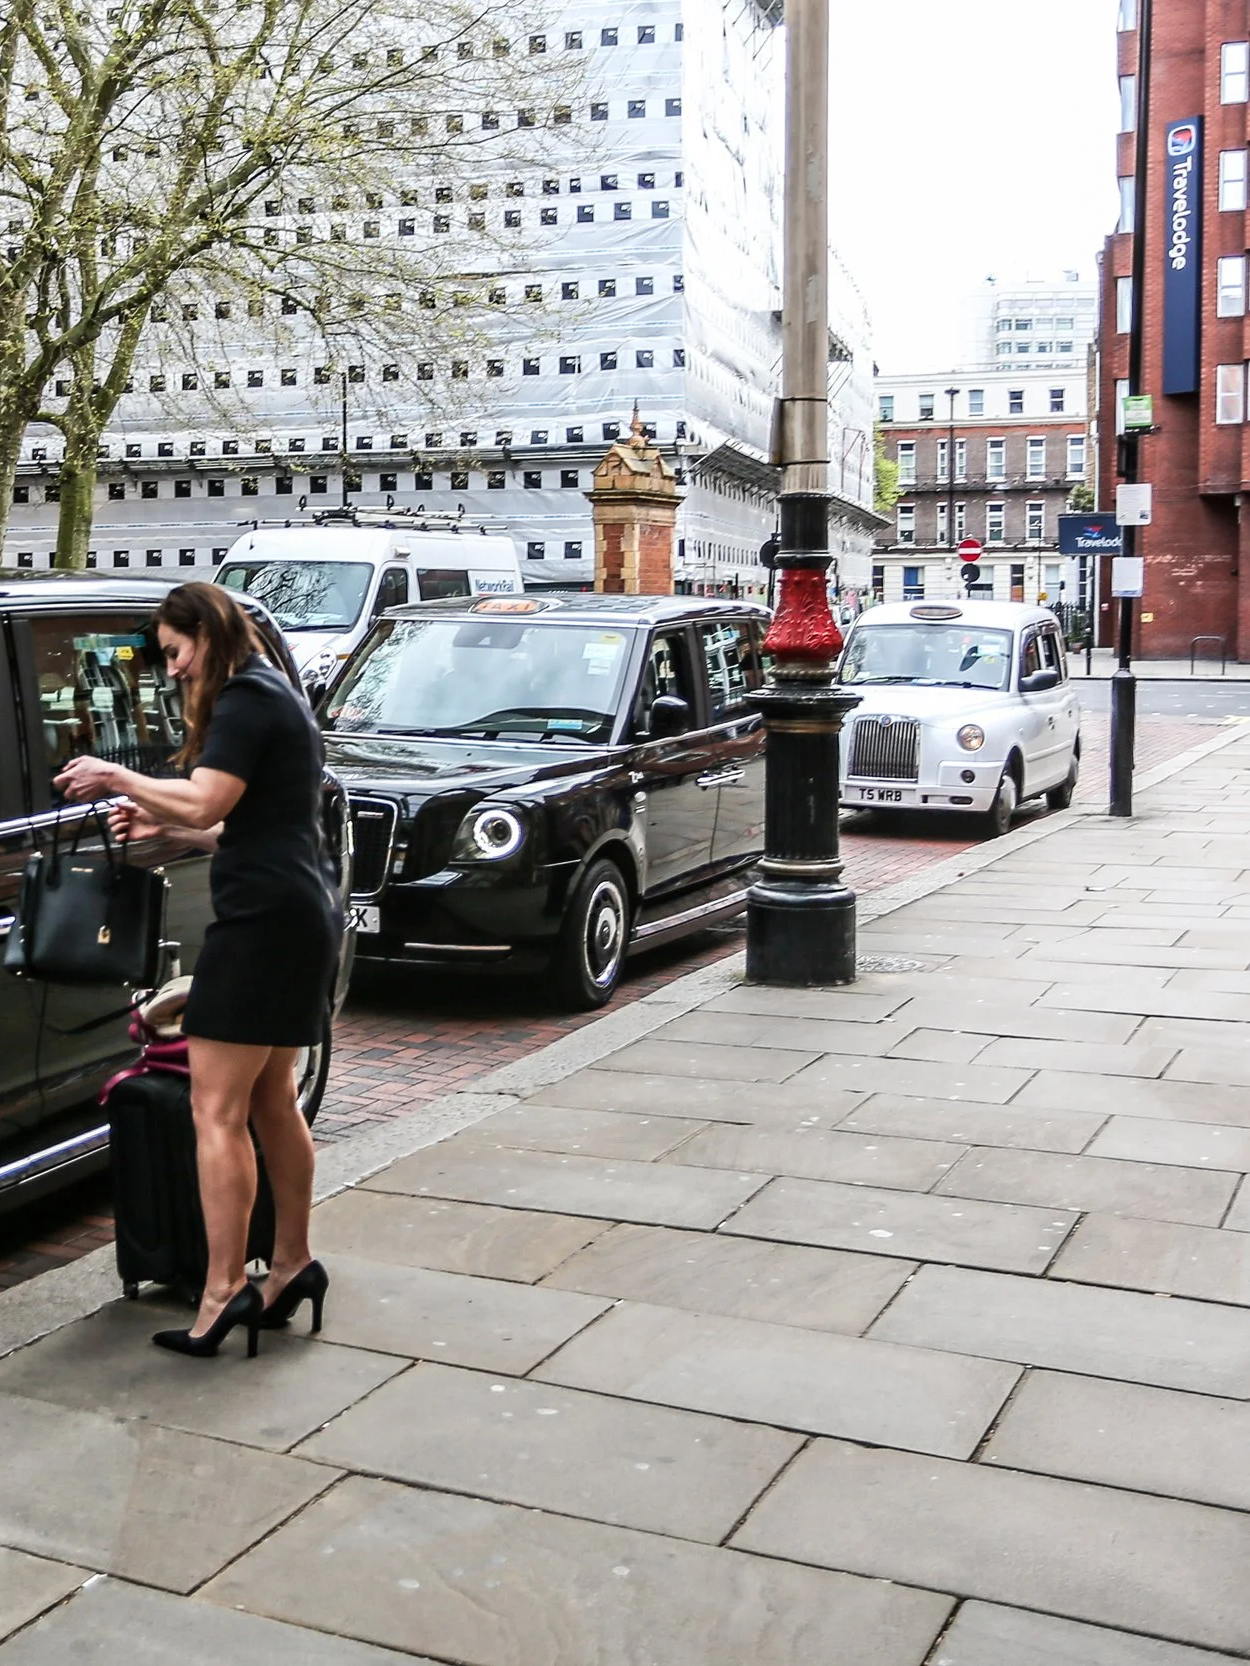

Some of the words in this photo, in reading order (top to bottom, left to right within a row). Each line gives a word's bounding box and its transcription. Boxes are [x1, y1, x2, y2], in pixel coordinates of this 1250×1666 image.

[1168, 155, 1193, 271] Travelodge
[480, 602, 531, 611] TAXI
[878, 789, 902, 802] WRB
